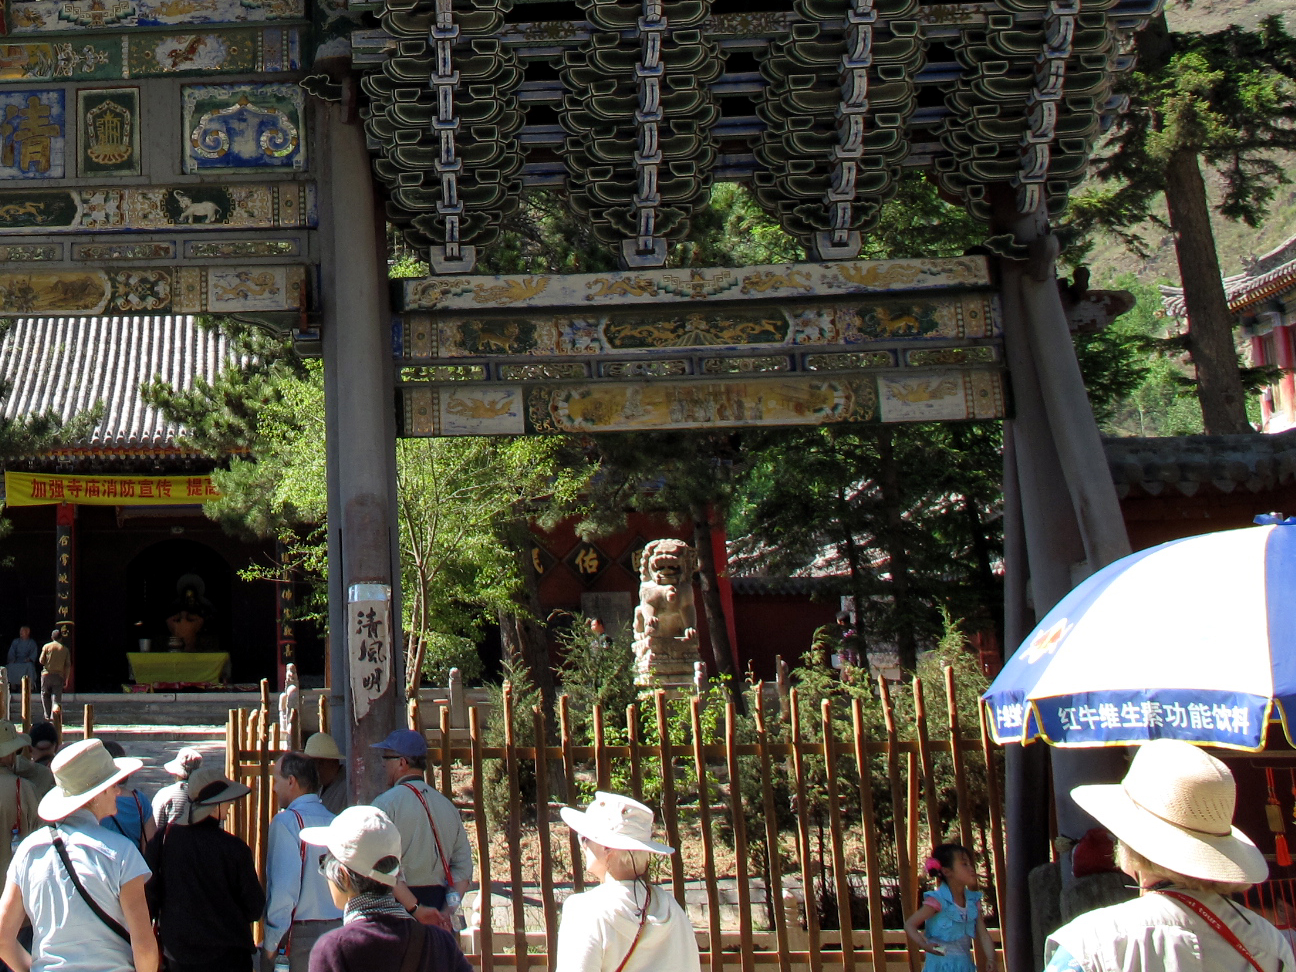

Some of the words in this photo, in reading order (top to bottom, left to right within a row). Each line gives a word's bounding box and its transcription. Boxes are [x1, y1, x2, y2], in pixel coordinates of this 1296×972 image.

[30, 478, 172, 499] 加强寺庙消防宣传
[1057, 701, 1250, 736] 红牛维生素功能饮料
